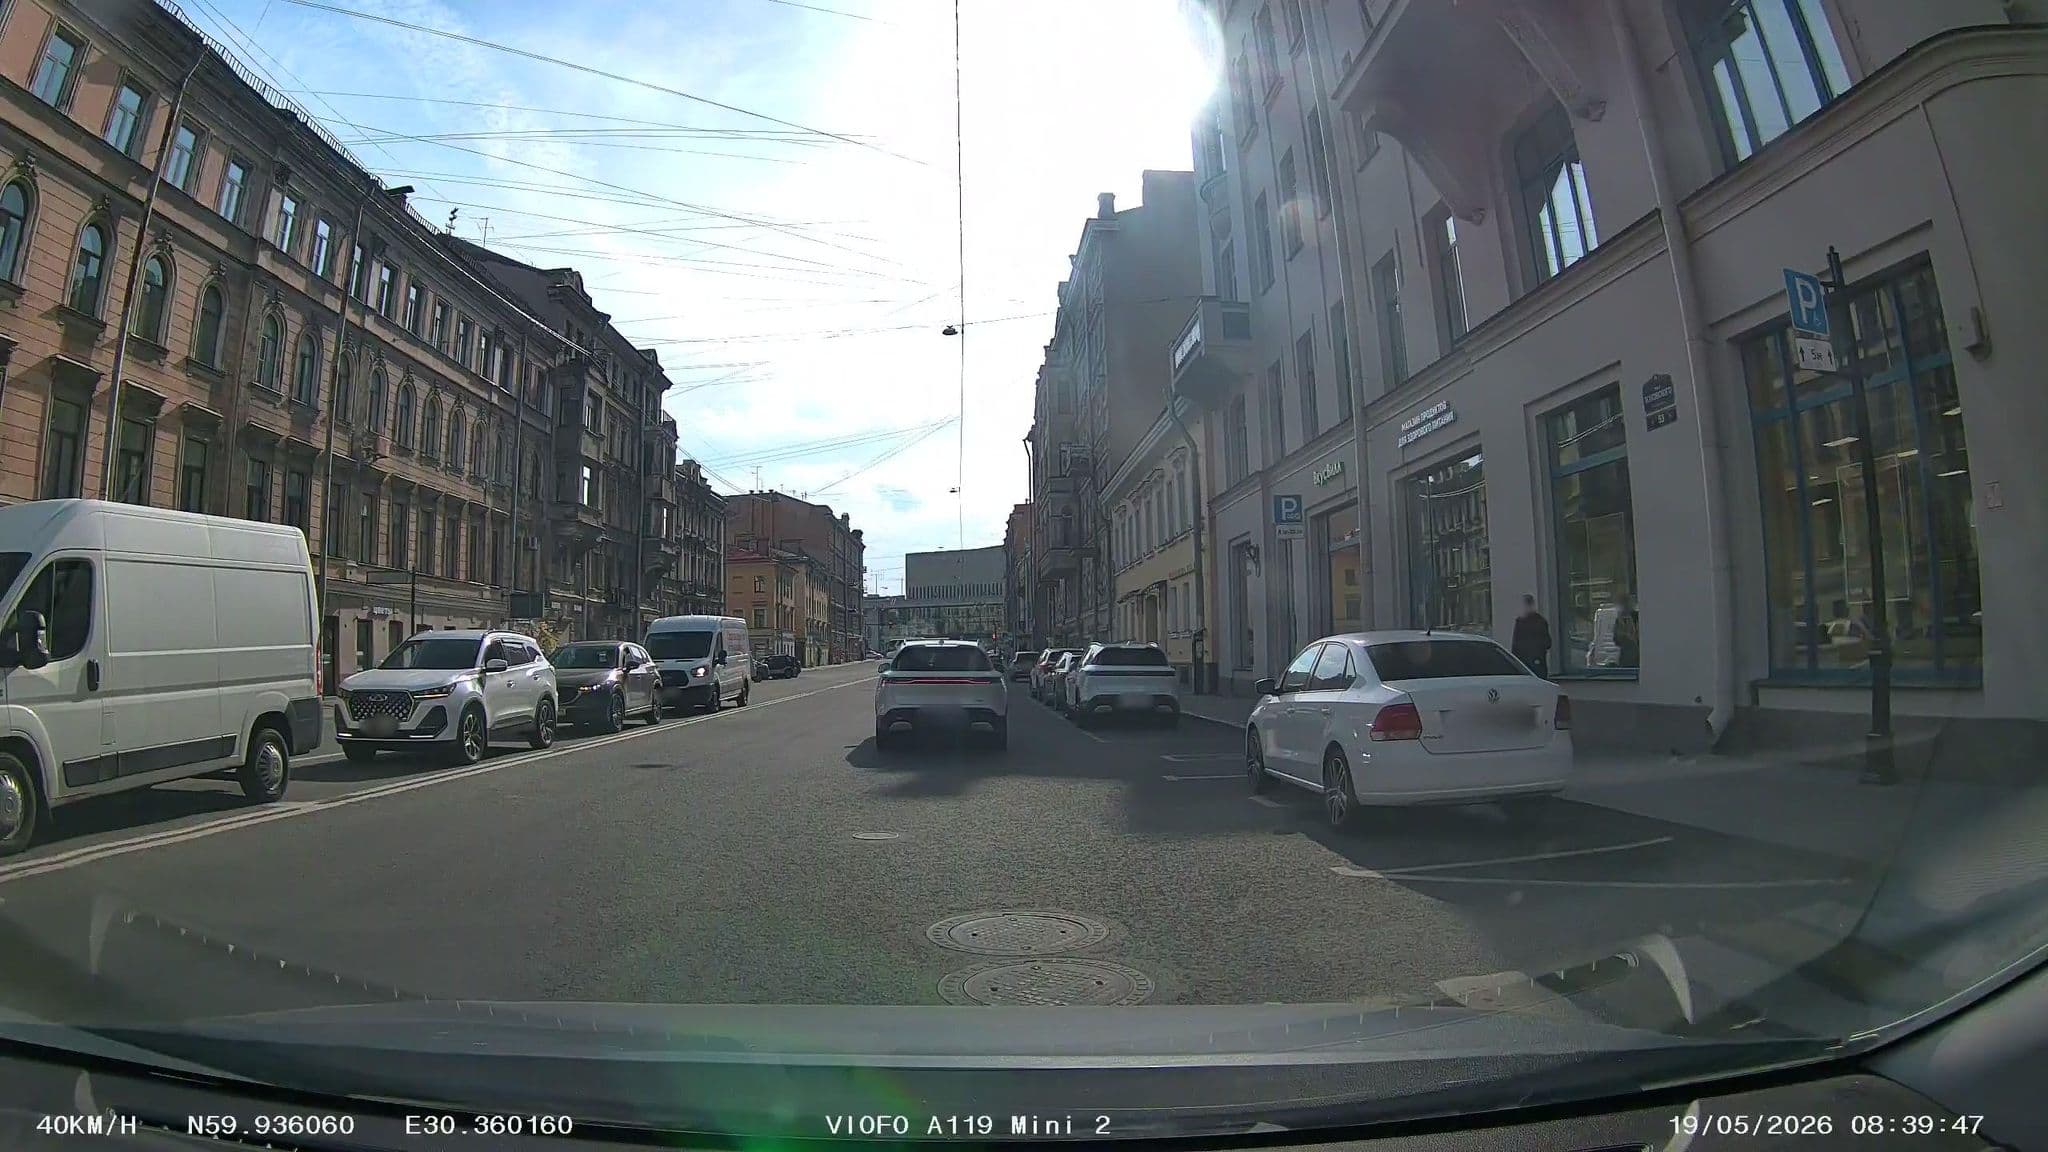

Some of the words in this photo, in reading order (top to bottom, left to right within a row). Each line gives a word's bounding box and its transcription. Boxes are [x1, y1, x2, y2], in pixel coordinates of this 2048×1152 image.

[1794, 276, 1817, 324] P
[1397, 435, 1407, 448] ДЛЯ
[1407, 422, 1432, 443] ЗДОРОВОГО
[1431, 410, 1454, 430] ПИТАНИЯ
[1401, 414, 1421, 432] МАГАЗИН
[1420, 400, 1447, 422] ПРОДУКТОВ
[1281, 497, 1297, 521] P
